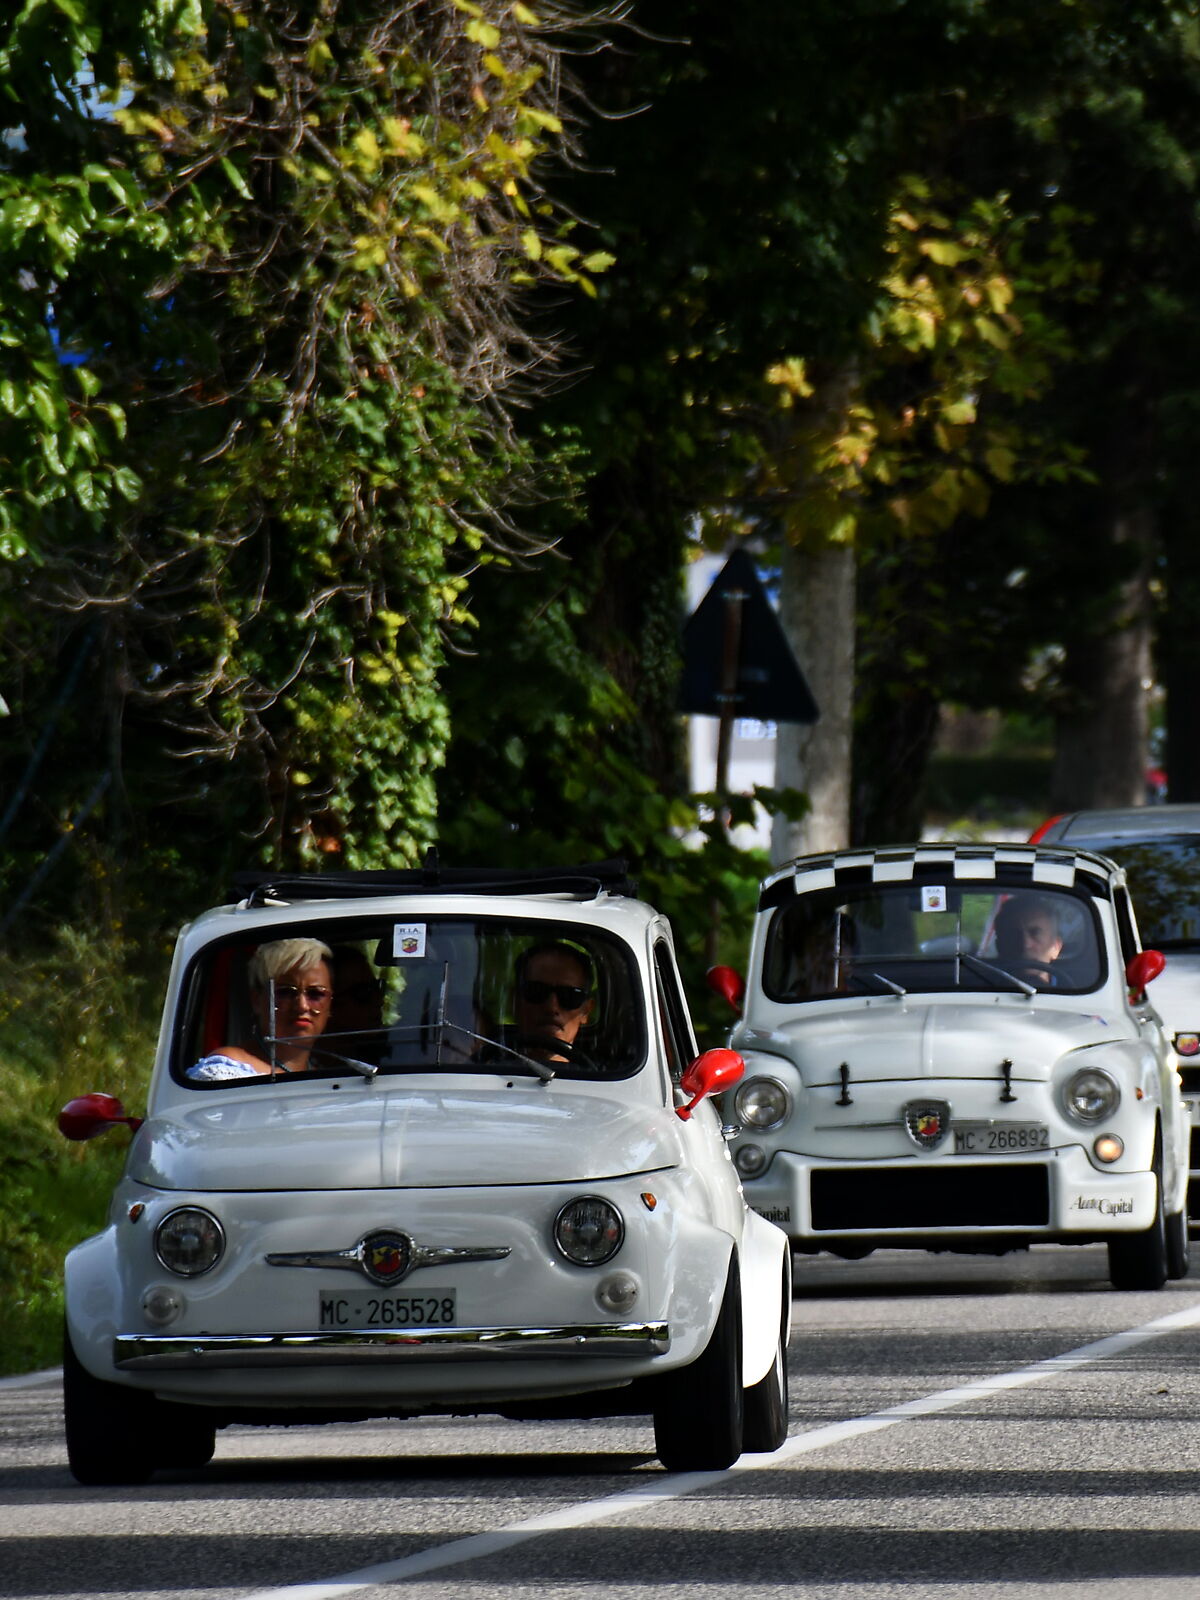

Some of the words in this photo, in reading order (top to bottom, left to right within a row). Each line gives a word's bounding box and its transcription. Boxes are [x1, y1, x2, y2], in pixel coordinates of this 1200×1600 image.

[955, 1132, 975, 1150] MC
[988, 1129, 1049, 1149] 266892
[321, 1299, 349, 1325] MC
[367, 1298, 454, 1324] 265528
